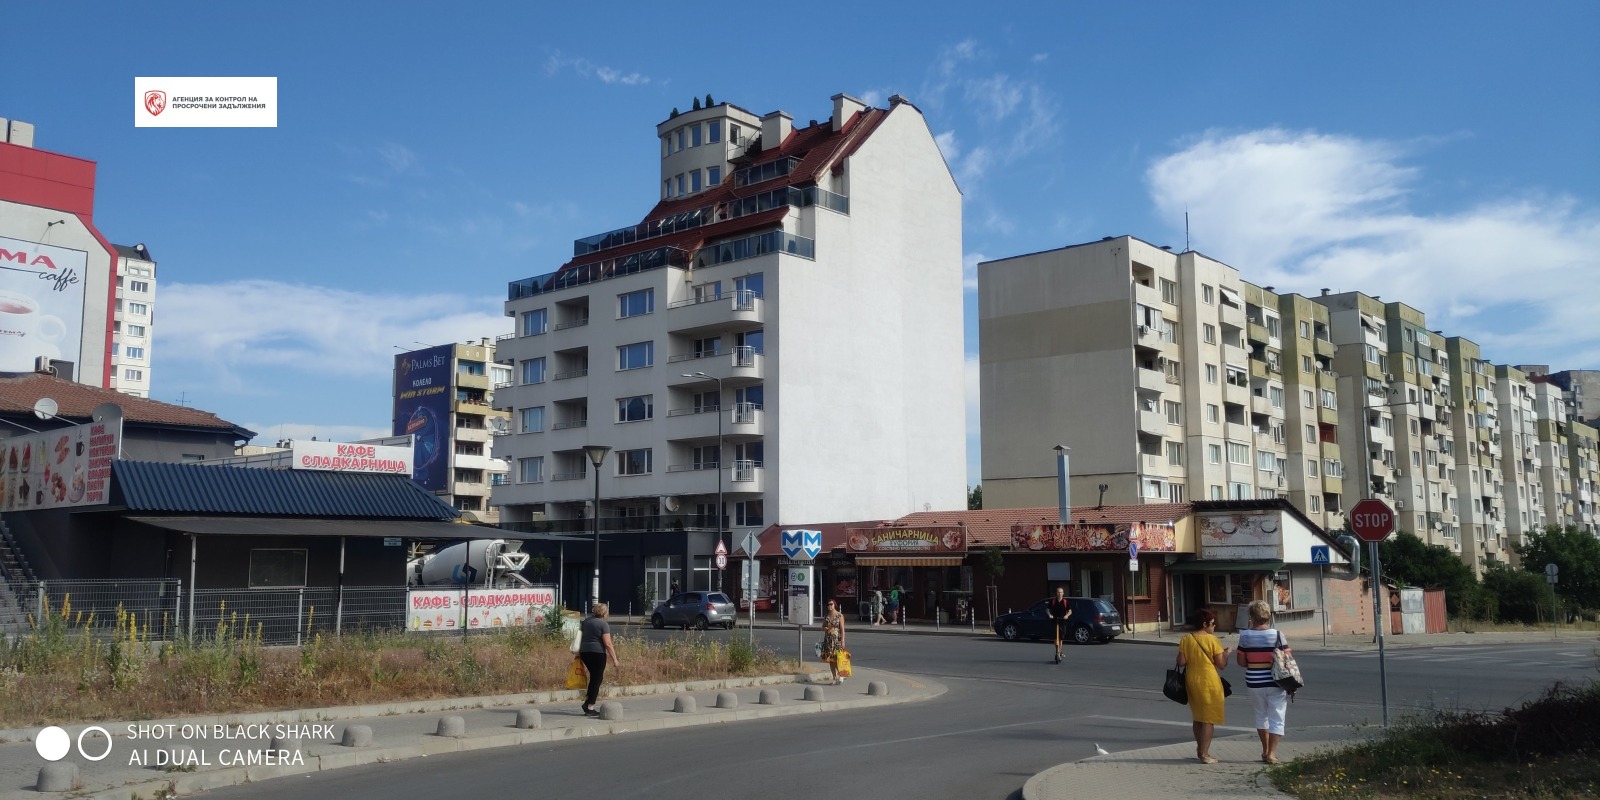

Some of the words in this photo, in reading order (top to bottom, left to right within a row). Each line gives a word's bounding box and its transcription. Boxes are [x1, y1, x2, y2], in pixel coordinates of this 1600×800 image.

[39, 267, 79, 292] caffè
[412, 378, 432, 388] КОЛЕЛО
[416, 386, 446, 397] STORM
[337, 444, 375, 458] КАФЕ
[302, 455, 407, 472] СЛАДКАРНИЦА
[1355, 513, 1389, 528] STOP
[871, 530, 939, 546] БАНИЧАРНИЦА
[1054, 538, 1091, 549] СКАРА
[413, 596, 451, 609] КАФЕ
[460, 593, 554, 608] СЛАДКАРНИЦА
